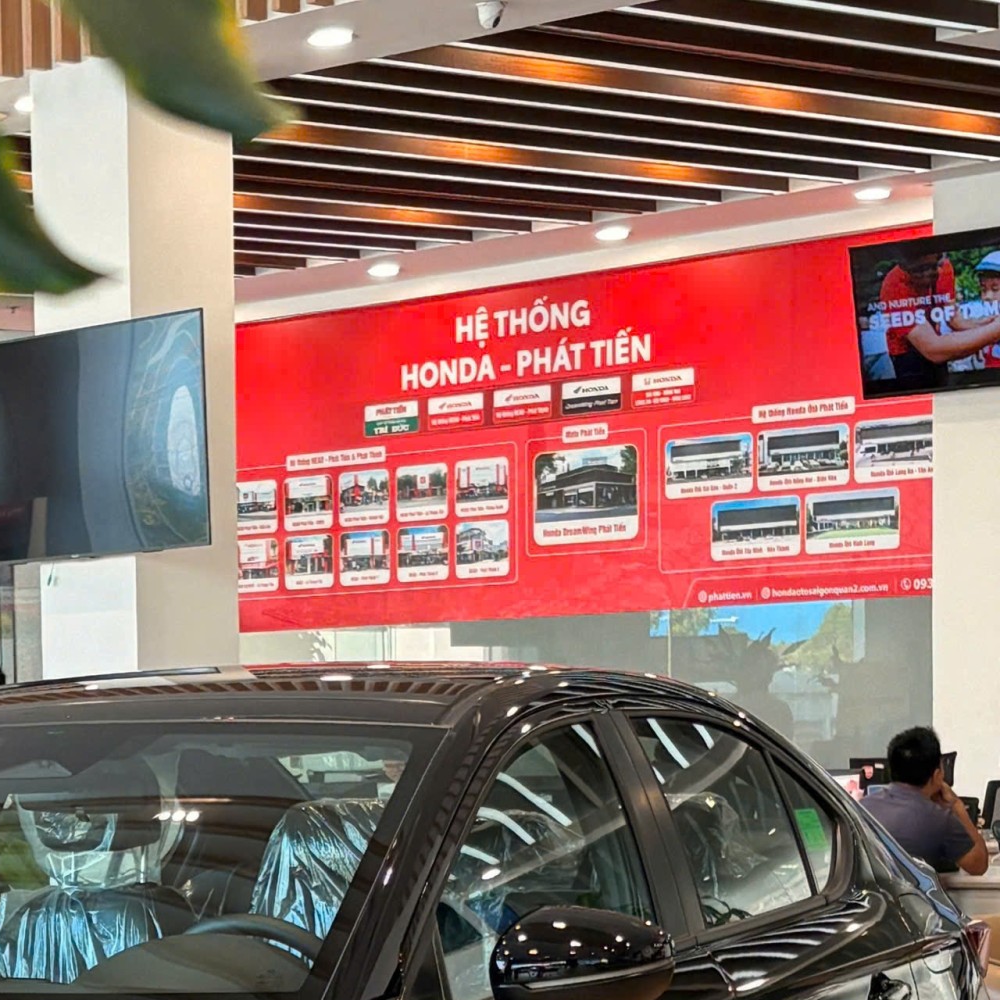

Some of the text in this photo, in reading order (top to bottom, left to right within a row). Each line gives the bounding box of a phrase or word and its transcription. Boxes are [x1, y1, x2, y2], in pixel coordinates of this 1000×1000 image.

[867, 293, 951, 312] AND NURTURE THE
[869, 309, 926, 330] SEEDS
[930, 306, 955, 322] OF
[455, 296, 591, 348] HỆ THỐNG
[401, 354, 496, 391] HONDA
[517, 337, 586, 377] PHÁT
[590, 327, 651, 368] TIẾN
